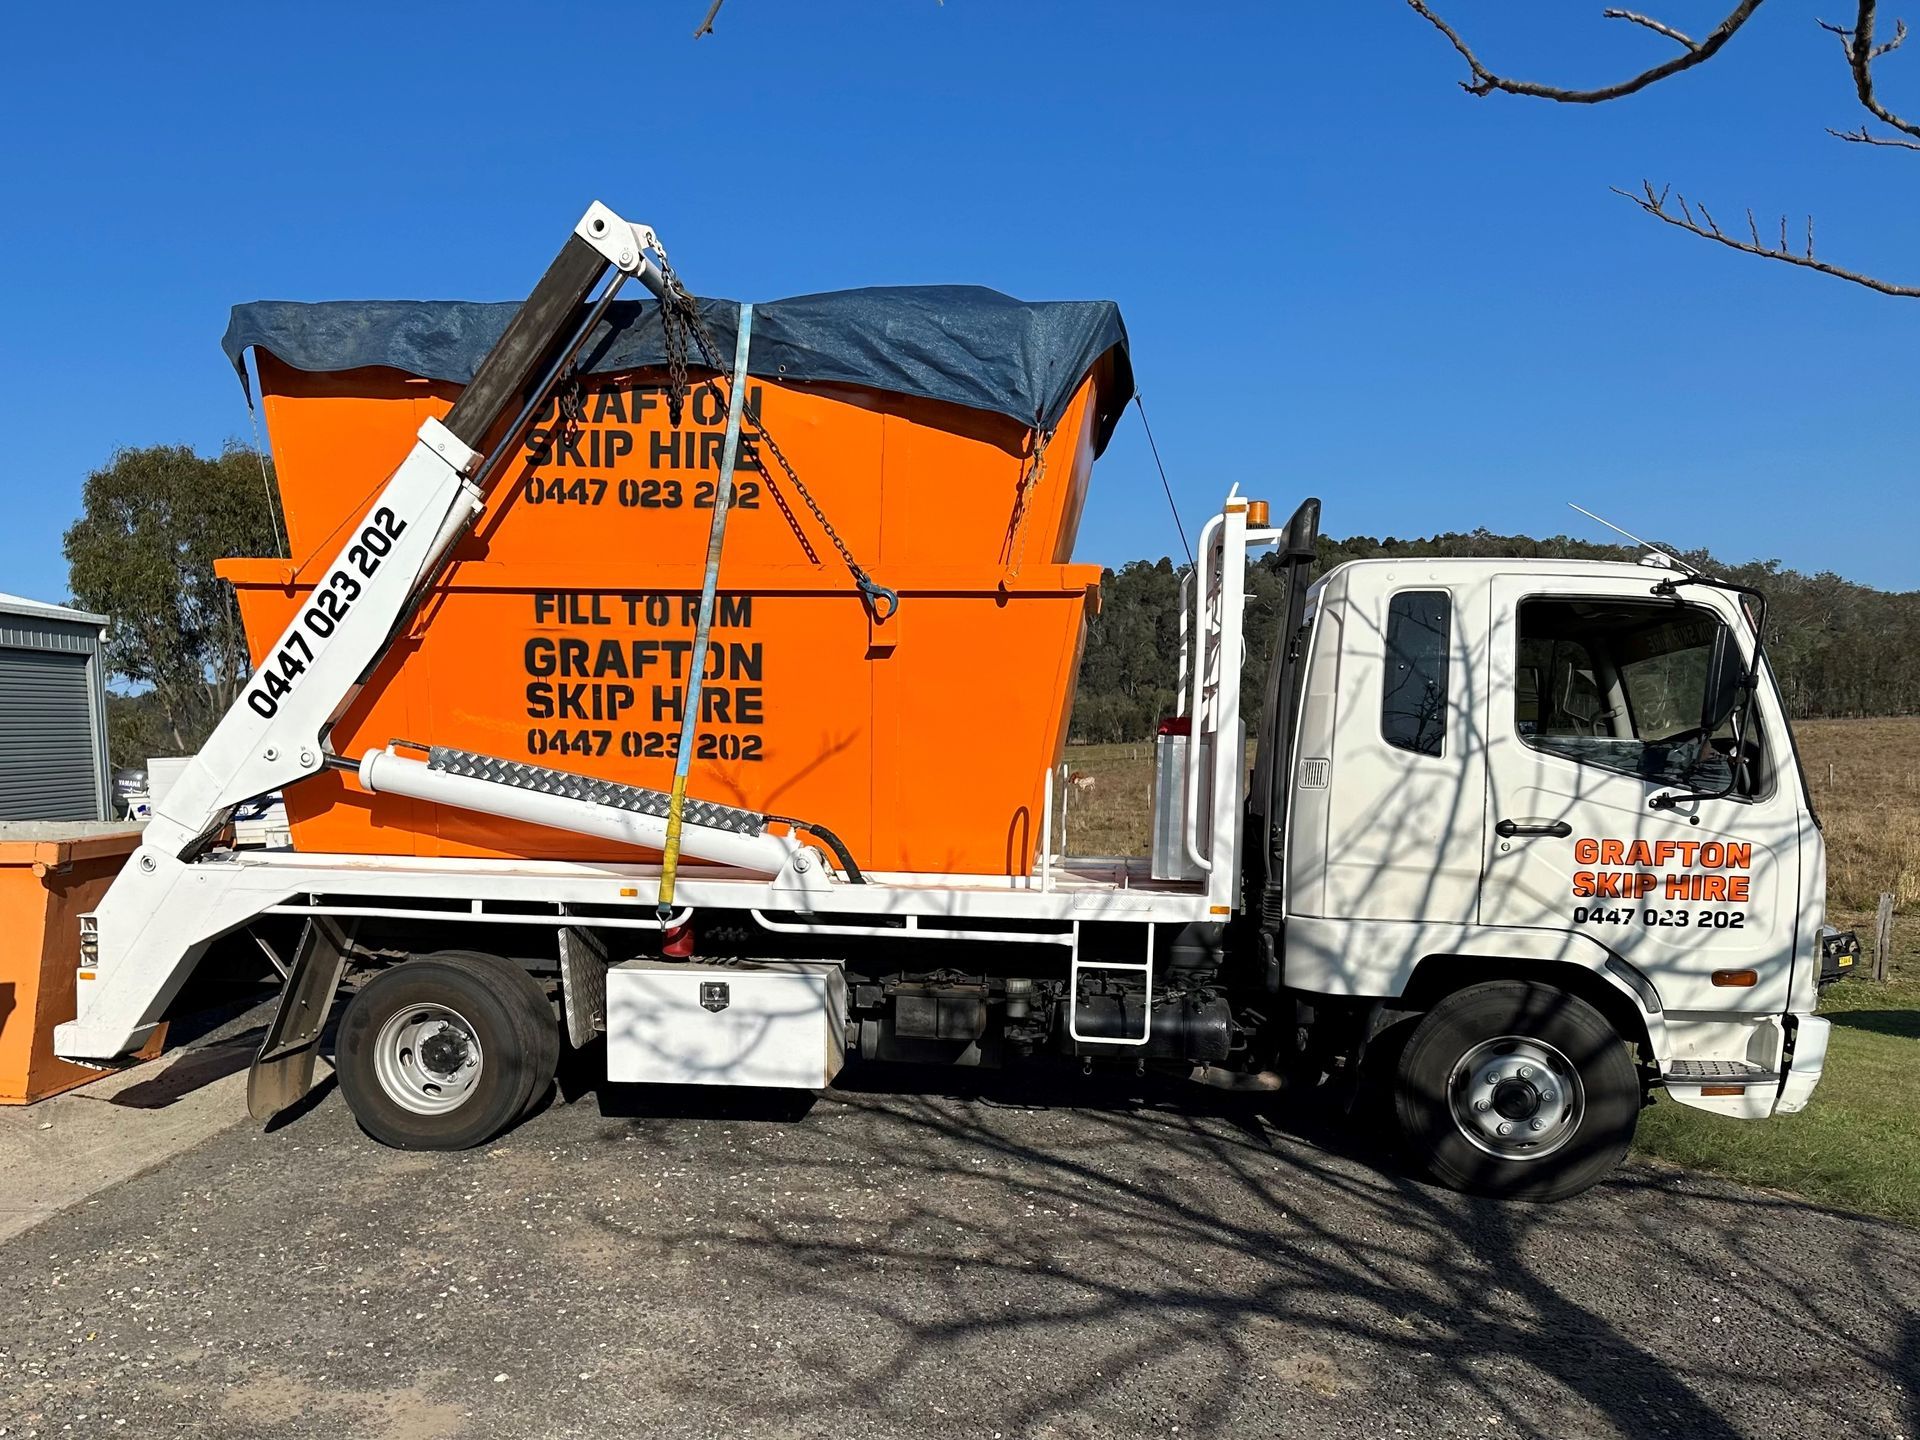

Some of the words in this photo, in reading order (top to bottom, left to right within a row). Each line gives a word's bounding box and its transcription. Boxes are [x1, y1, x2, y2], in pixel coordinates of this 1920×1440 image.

[525, 428, 633, 468] SKIP
[650, 431, 760, 471] HIRE
[525, 478, 608, 505] 0447
[619, 479, 683, 508] 023
[247, 630, 314, 719] 0447
[303, 570, 361, 639] 023
[348, 507, 408, 579] 202
[534, 594, 611, 625] FILL
[621, 595, 670, 627] TO
[524, 637, 763, 682] GRAFTON
[526, 682, 635, 721] SKIP
[652, 685, 764, 724] HRE
[527, 728, 613, 757] 0447
[621, 731, 681, 758] 023
[697, 733, 763, 761] 202
[1574, 838, 1751, 869] GRAFTON
[1572, 871, 1658, 899] SKIP
[1665, 874, 1750, 902] HIRE
[1573, 906, 1635, 925] 0447
[1643, 909, 1689, 927] 023
[1697, 911, 1745, 929] 202
